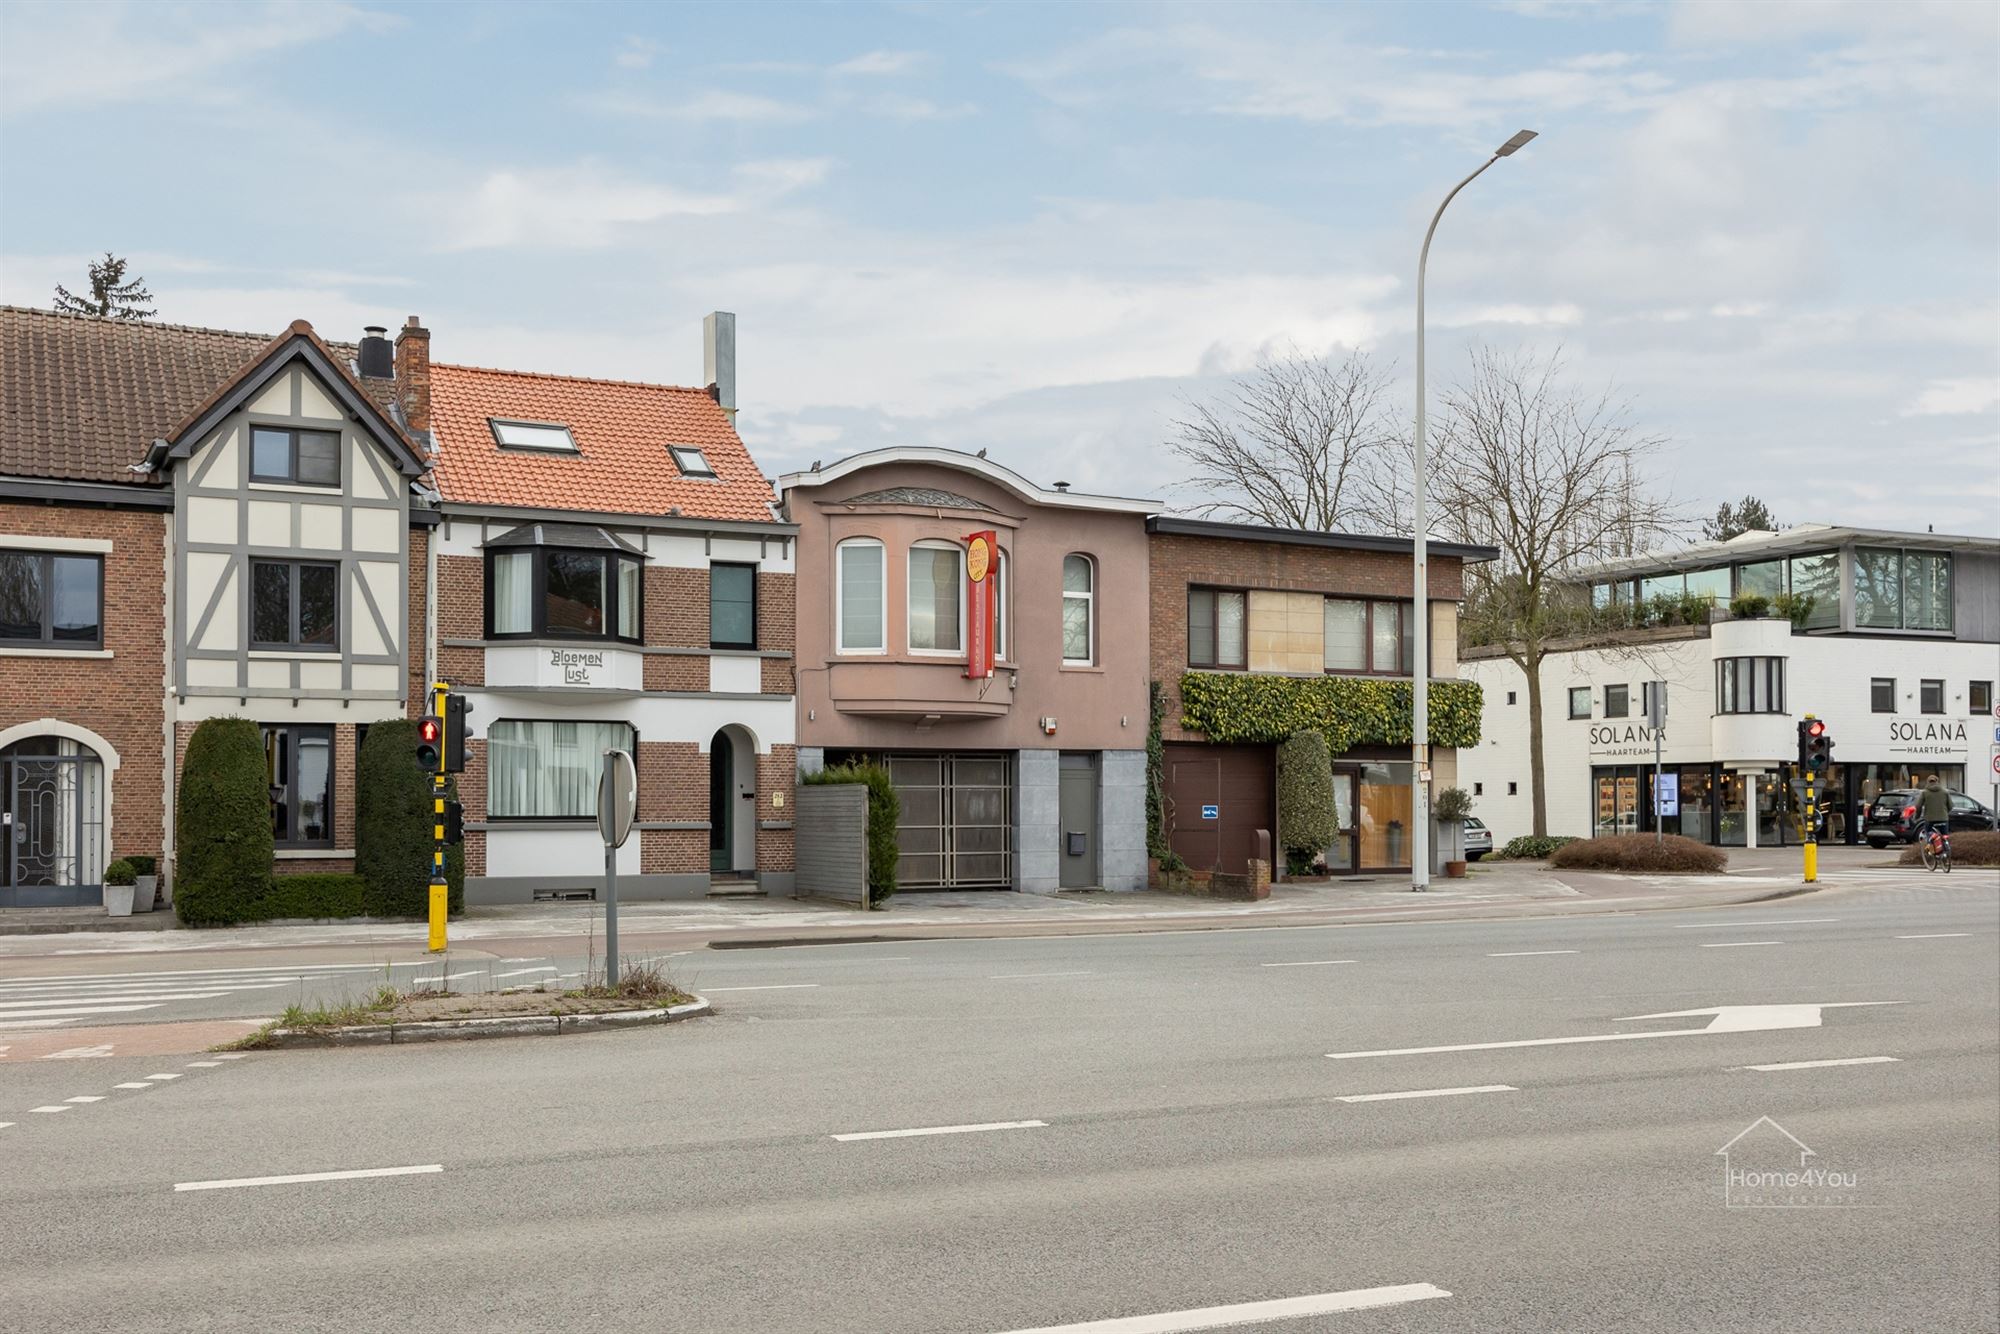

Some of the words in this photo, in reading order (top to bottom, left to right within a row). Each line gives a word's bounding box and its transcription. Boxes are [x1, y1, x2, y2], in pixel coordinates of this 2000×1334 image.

[565, 665, 590, 685] Lust
[1590, 725, 1667, 745] SOLANA
[1890, 722, 1967, 740] SOLANA
[1606, 748, 1650, 756] HAARTEAM
[1907, 746, 1952, 754] HAARTEAM
